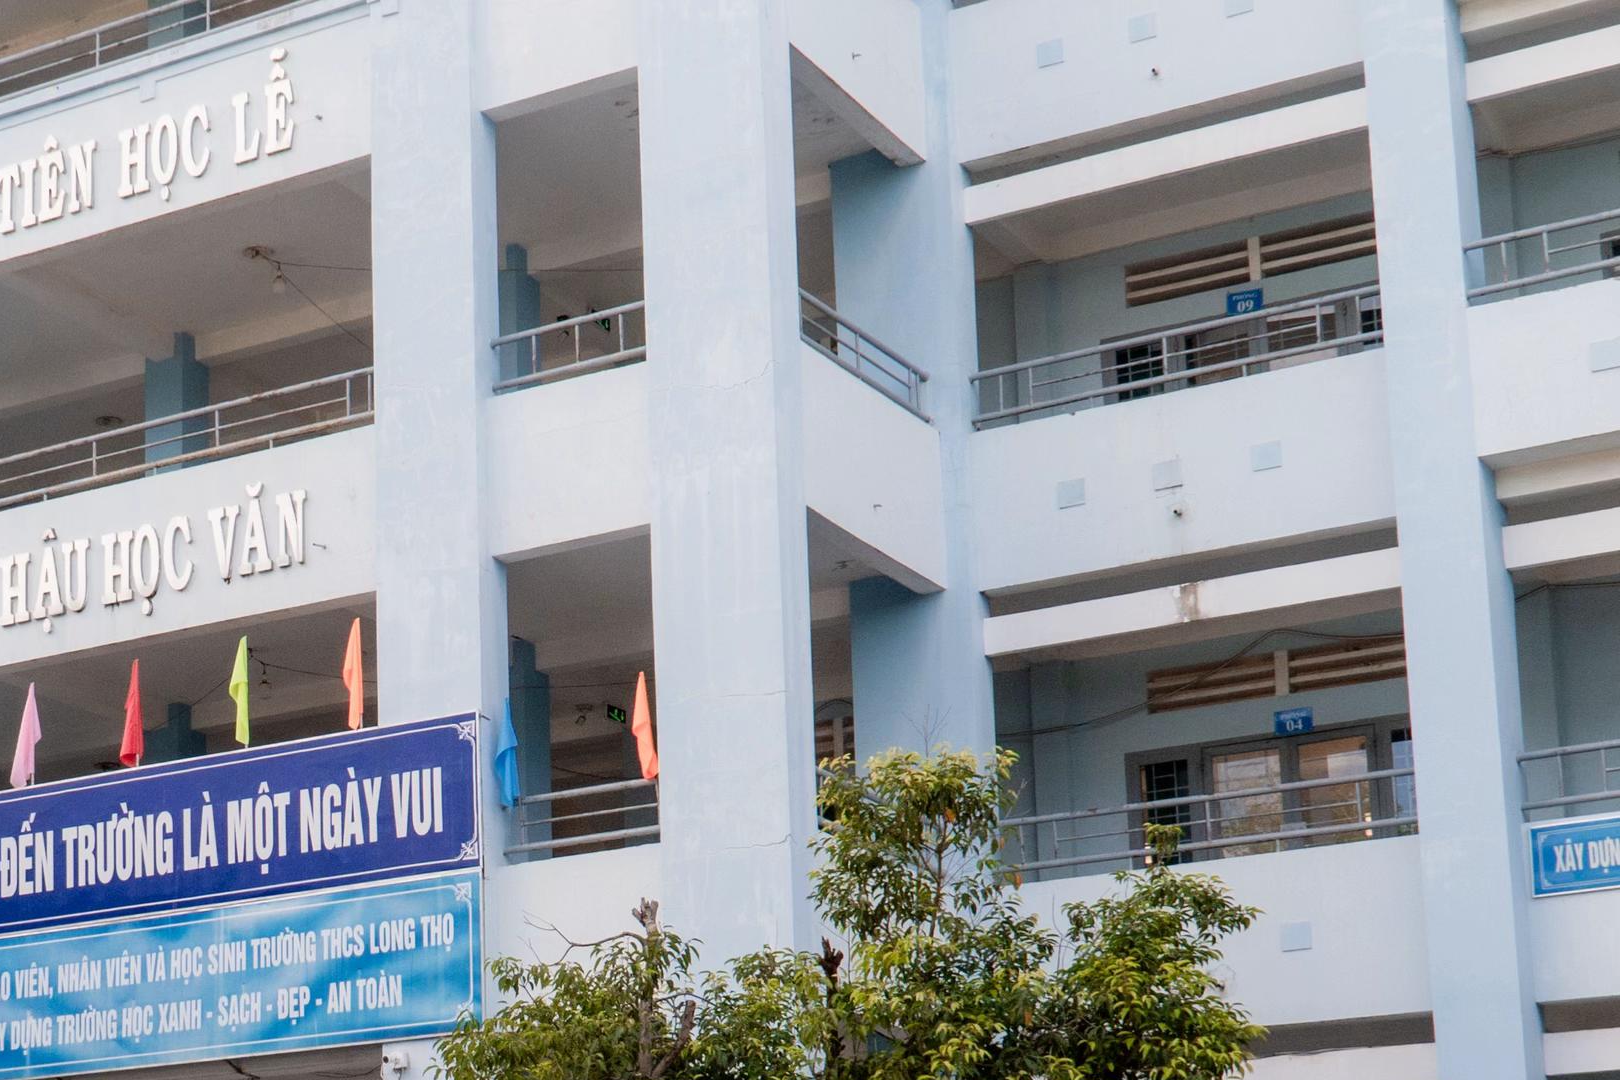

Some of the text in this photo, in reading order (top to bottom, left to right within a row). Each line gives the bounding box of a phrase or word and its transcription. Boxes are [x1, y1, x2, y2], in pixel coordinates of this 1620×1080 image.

[118, 104, 211, 201] HỌC
[1237, 299, 1254, 313] 09
[101, 515, 194, 616] HỌC
[207, 480, 307, 582] VĂN
[1286, 719, 1303, 731] 04
[0, 812, 55, 898] ĐẾN
[61, 802, 174, 889] TRƯỜNG
[183, 791, 219, 872] LÀ
[226, 781, 291, 875] MỘT
[299, 766, 382, 854] NGÀY
[390, 766, 443, 839] VUI
[1553, 838, 1584, 873] XÂY
[14, 962, 54, 999] VIÊN,
[58, 955, 102, 994] NHÂN
[105, 950, 142, 988] VIÊN
[146, 945, 166, 983] VÀ
[170, 946, 203, 985] HỌC
[207, 940, 247, 975] SINH
[251, 927, 316, 969] TRƯỜNG
[321, 924, 365, 960] THCS
[369, 917, 416, 954] LONG
[420, 912, 455, 951] THỌ
[10, 1013, 52, 1055] DỰNG
[56, 1005, 118, 1045] TRƯỜNG
[121, 1005, 154, 1043] HỌC
[158, 999, 202, 1034] XANH
[217, 991, 262, 1032] SẠCH
[277, 985, 310, 1025] ĐẸP
[327, 980, 351, 1014] AN
[356, 970, 402, 1010] TOÀN
